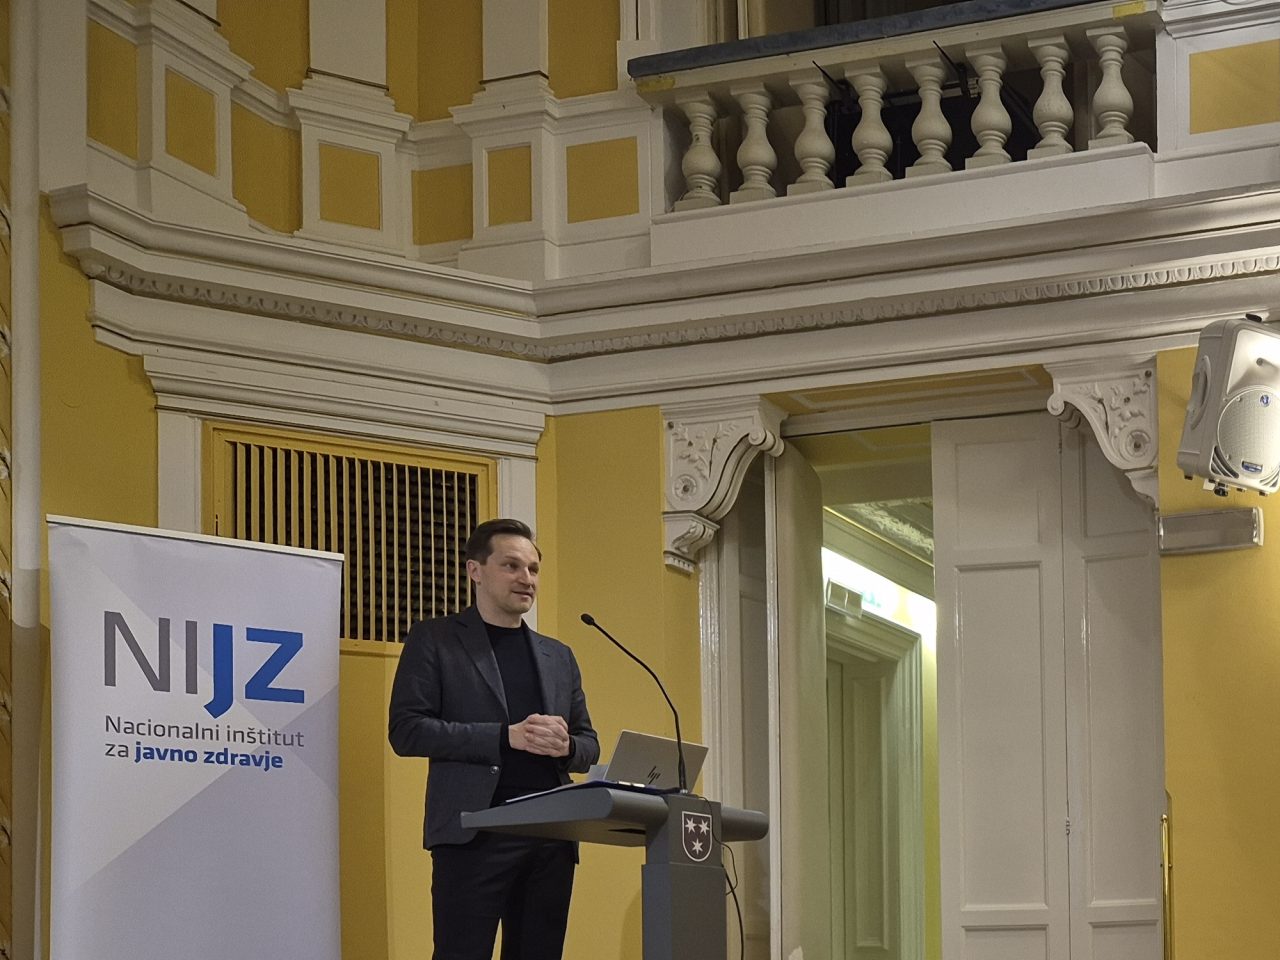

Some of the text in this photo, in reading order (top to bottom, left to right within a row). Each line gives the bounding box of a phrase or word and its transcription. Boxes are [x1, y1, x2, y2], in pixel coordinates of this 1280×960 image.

[104, 611, 305, 719] NIJZ
[105, 715, 305, 747] Nacionalni inštitut
[104, 741, 283, 772] za javno zdravje
